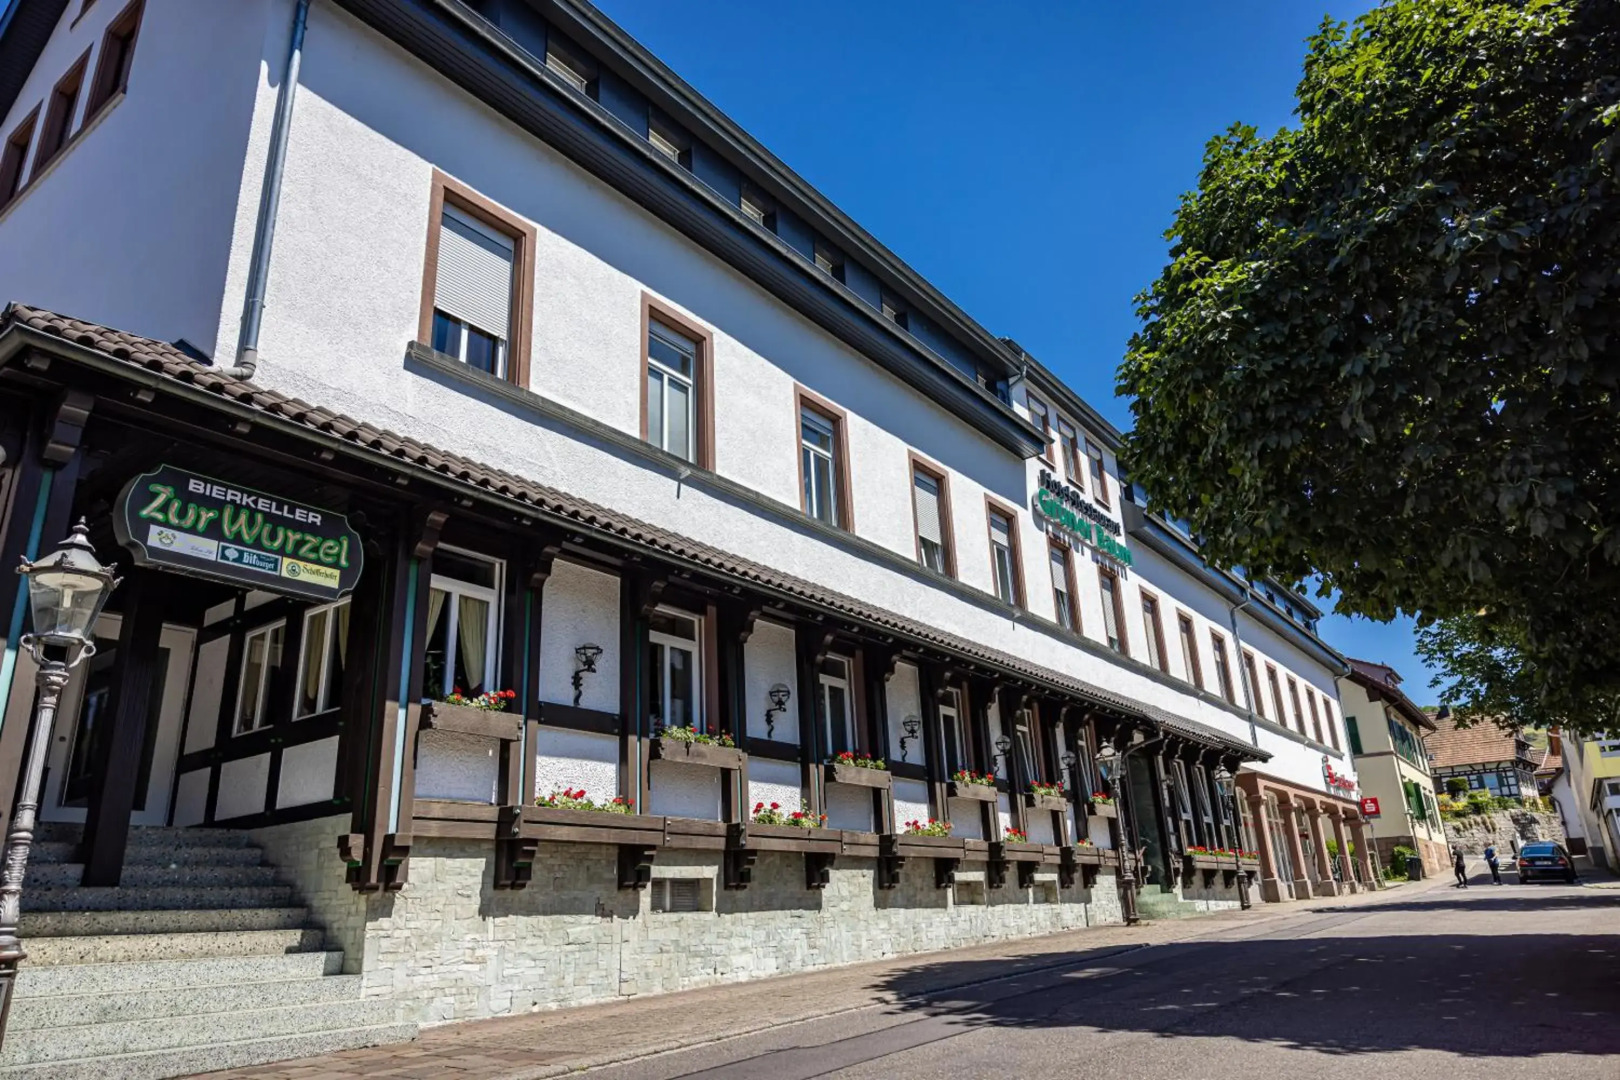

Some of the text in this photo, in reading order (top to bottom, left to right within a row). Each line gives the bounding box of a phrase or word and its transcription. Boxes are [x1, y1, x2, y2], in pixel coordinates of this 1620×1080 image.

[188, 478, 323, 525] BIERKELLER
[140, 484, 350, 568] Zur Wurzel
[1094, 523, 1132, 566] Baum
